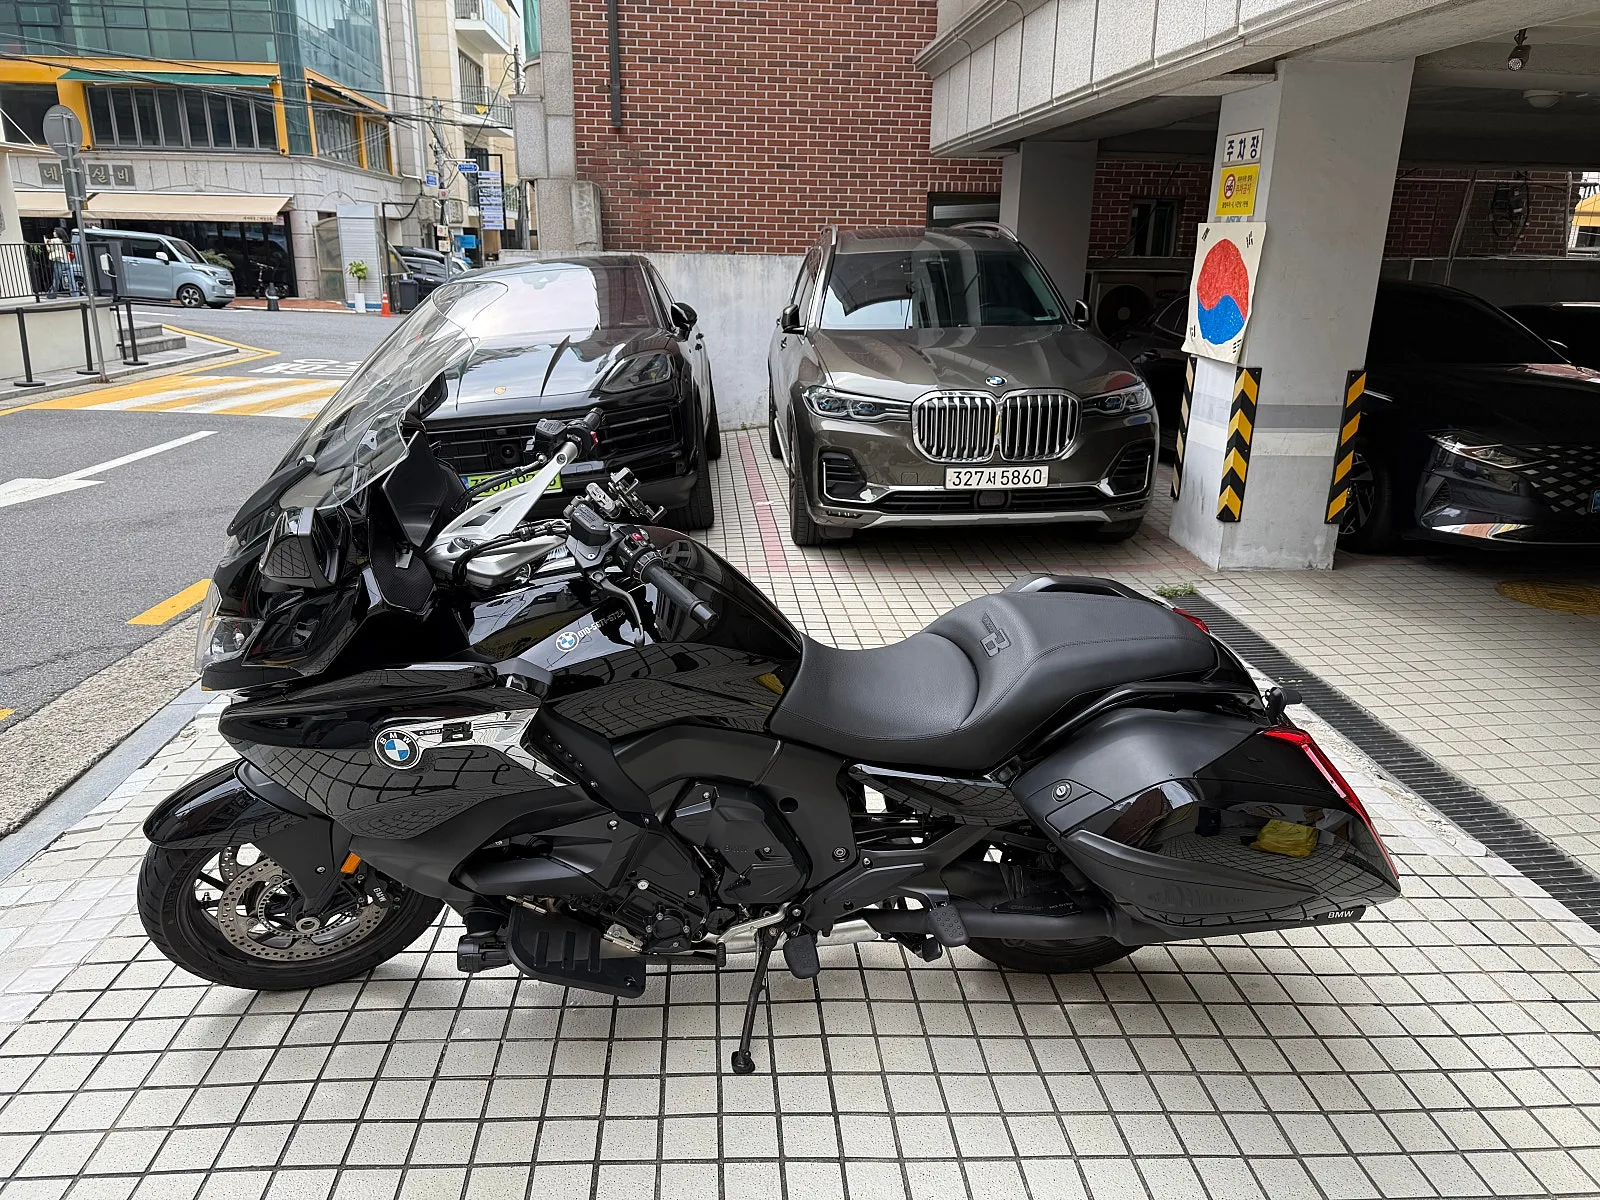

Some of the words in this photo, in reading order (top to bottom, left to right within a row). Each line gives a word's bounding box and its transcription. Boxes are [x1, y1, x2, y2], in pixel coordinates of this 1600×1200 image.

[1226, 135, 1260, 163] 주차장
[42, 165, 129, 184] 네실비
[952, 468, 1043, 487] 327서5860
[373, 887, 387, 902] BMW
[1327, 910, 1354, 919] BMW
